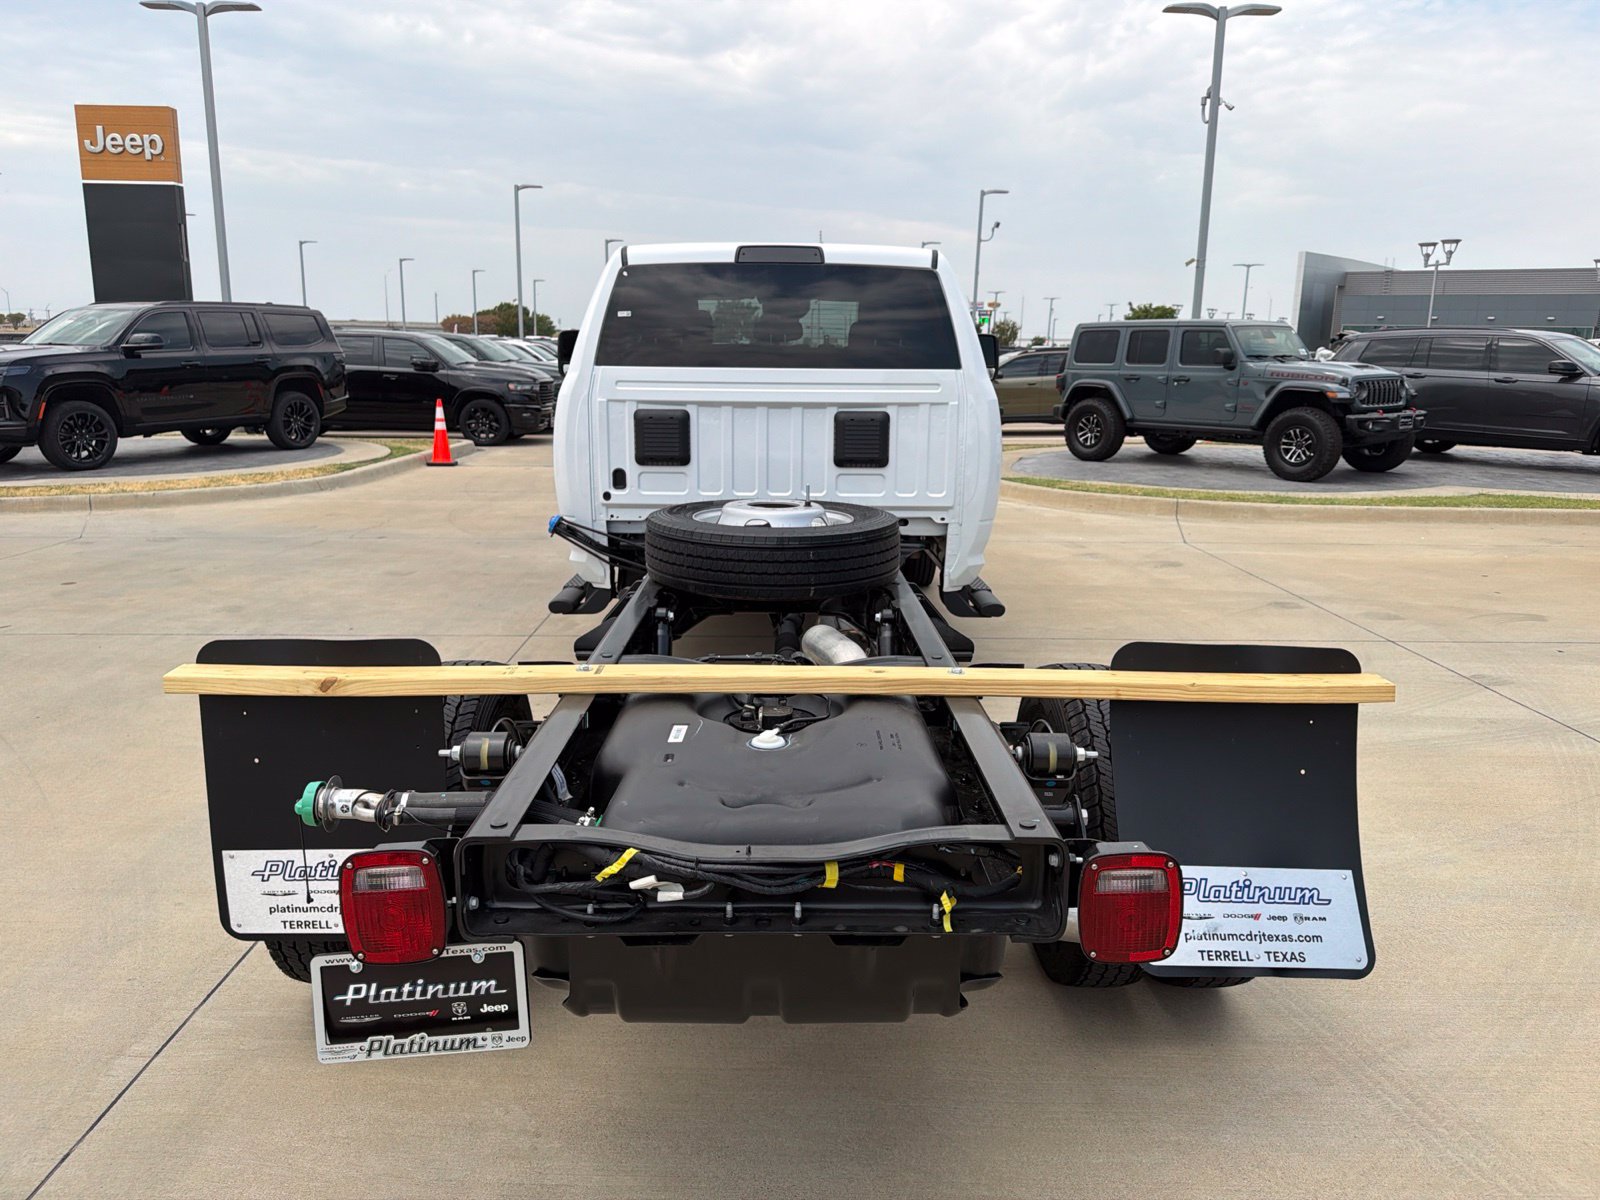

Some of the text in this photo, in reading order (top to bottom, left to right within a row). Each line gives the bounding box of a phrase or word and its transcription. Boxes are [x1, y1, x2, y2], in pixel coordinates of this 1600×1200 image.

[83, 125, 164, 160] Jeep
[1270, 370, 1336, 382] RUBICON
[251, 859, 340, 882] Plati
[1182, 877, 1332, 906] Platinum
[281, 920, 332, 929] TERRELL
[1267, 914, 1288, 922] Jeep
[1197, 949, 1306, 963] TERRELL TEXAS
[333, 978, 508, 1006] Platinum
[480, 1003, 509, 1014] Jeep
[366, 1034, 488, 1059] Platinum
[505, 1035, 527, 1044] Jeep
